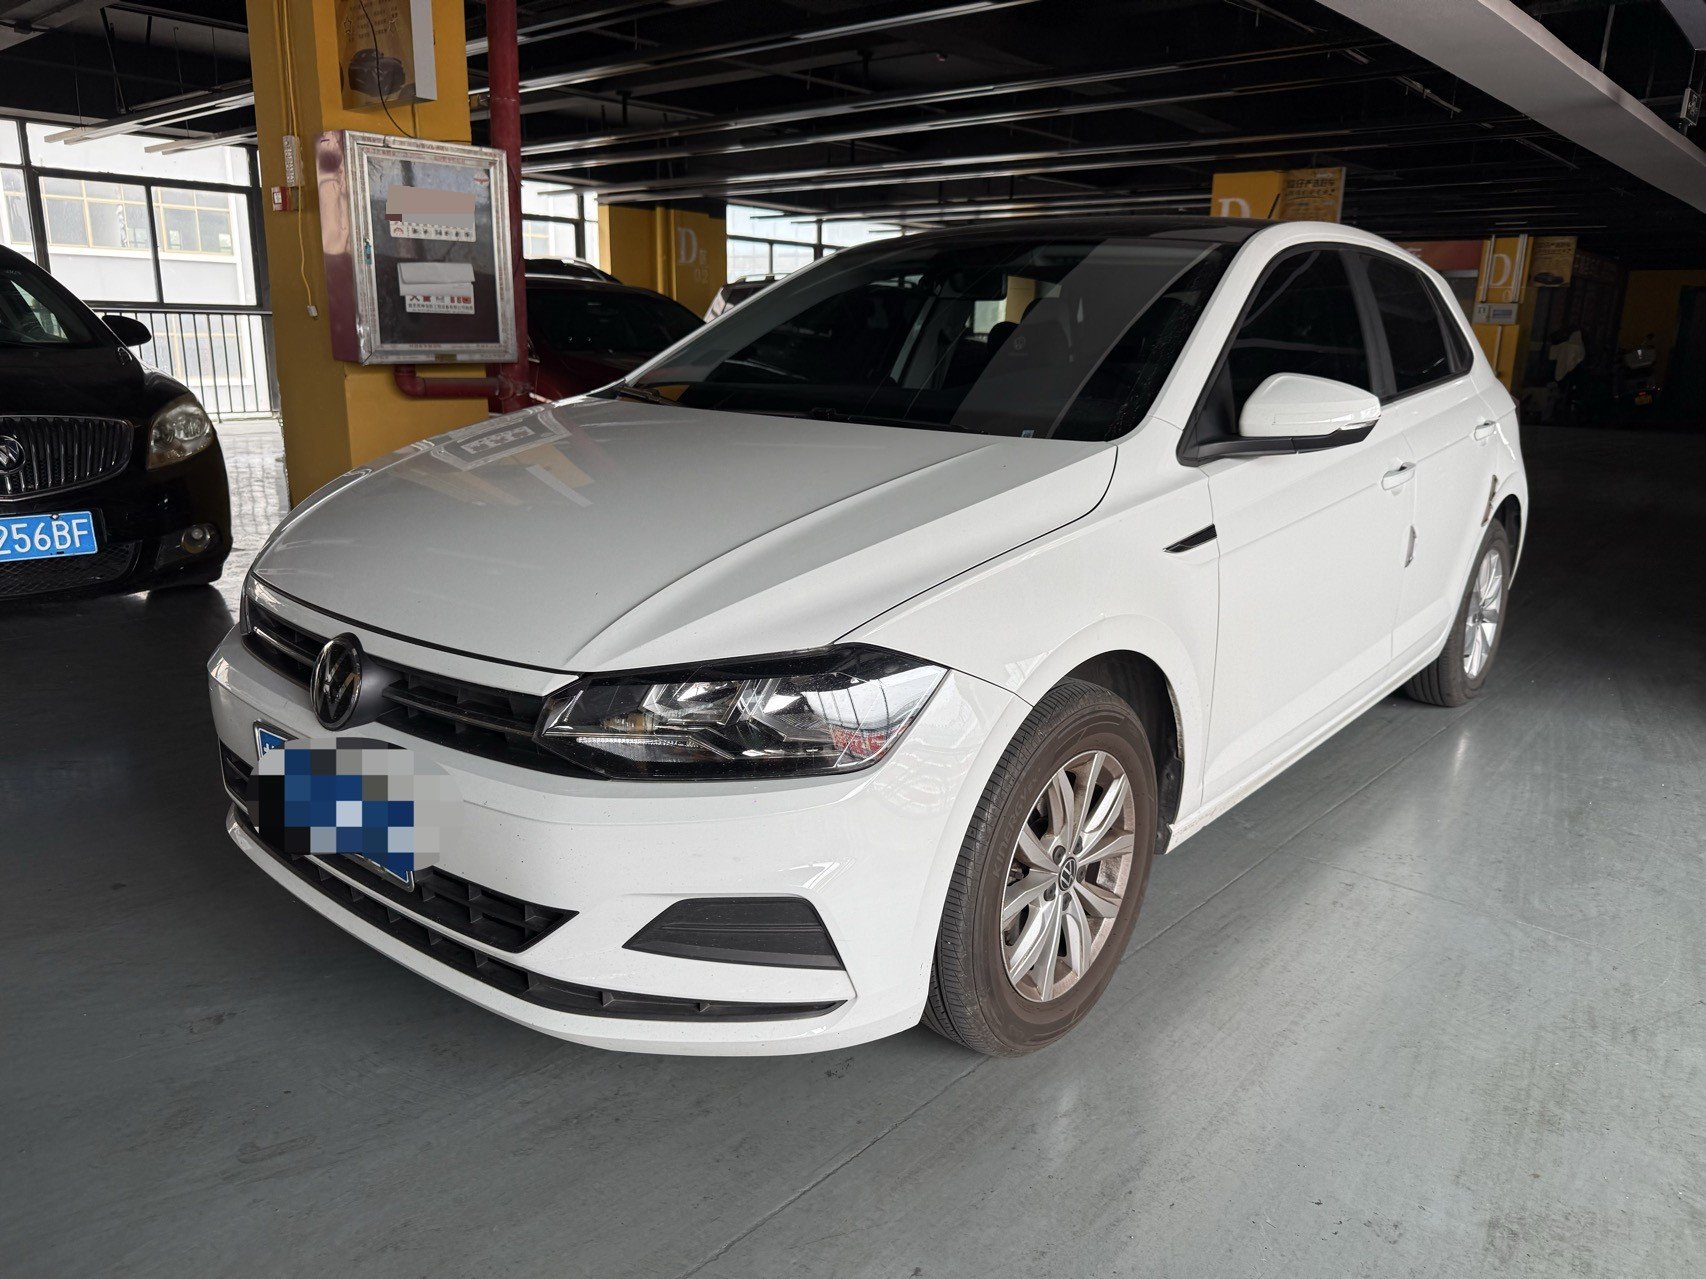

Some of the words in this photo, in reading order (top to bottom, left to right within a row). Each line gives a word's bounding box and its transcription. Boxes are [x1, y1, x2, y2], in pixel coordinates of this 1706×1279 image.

[677, 226, 698, 265] D
[1489, 253, 1511, 286] D
[0, 518, 88, 554] 256BF
